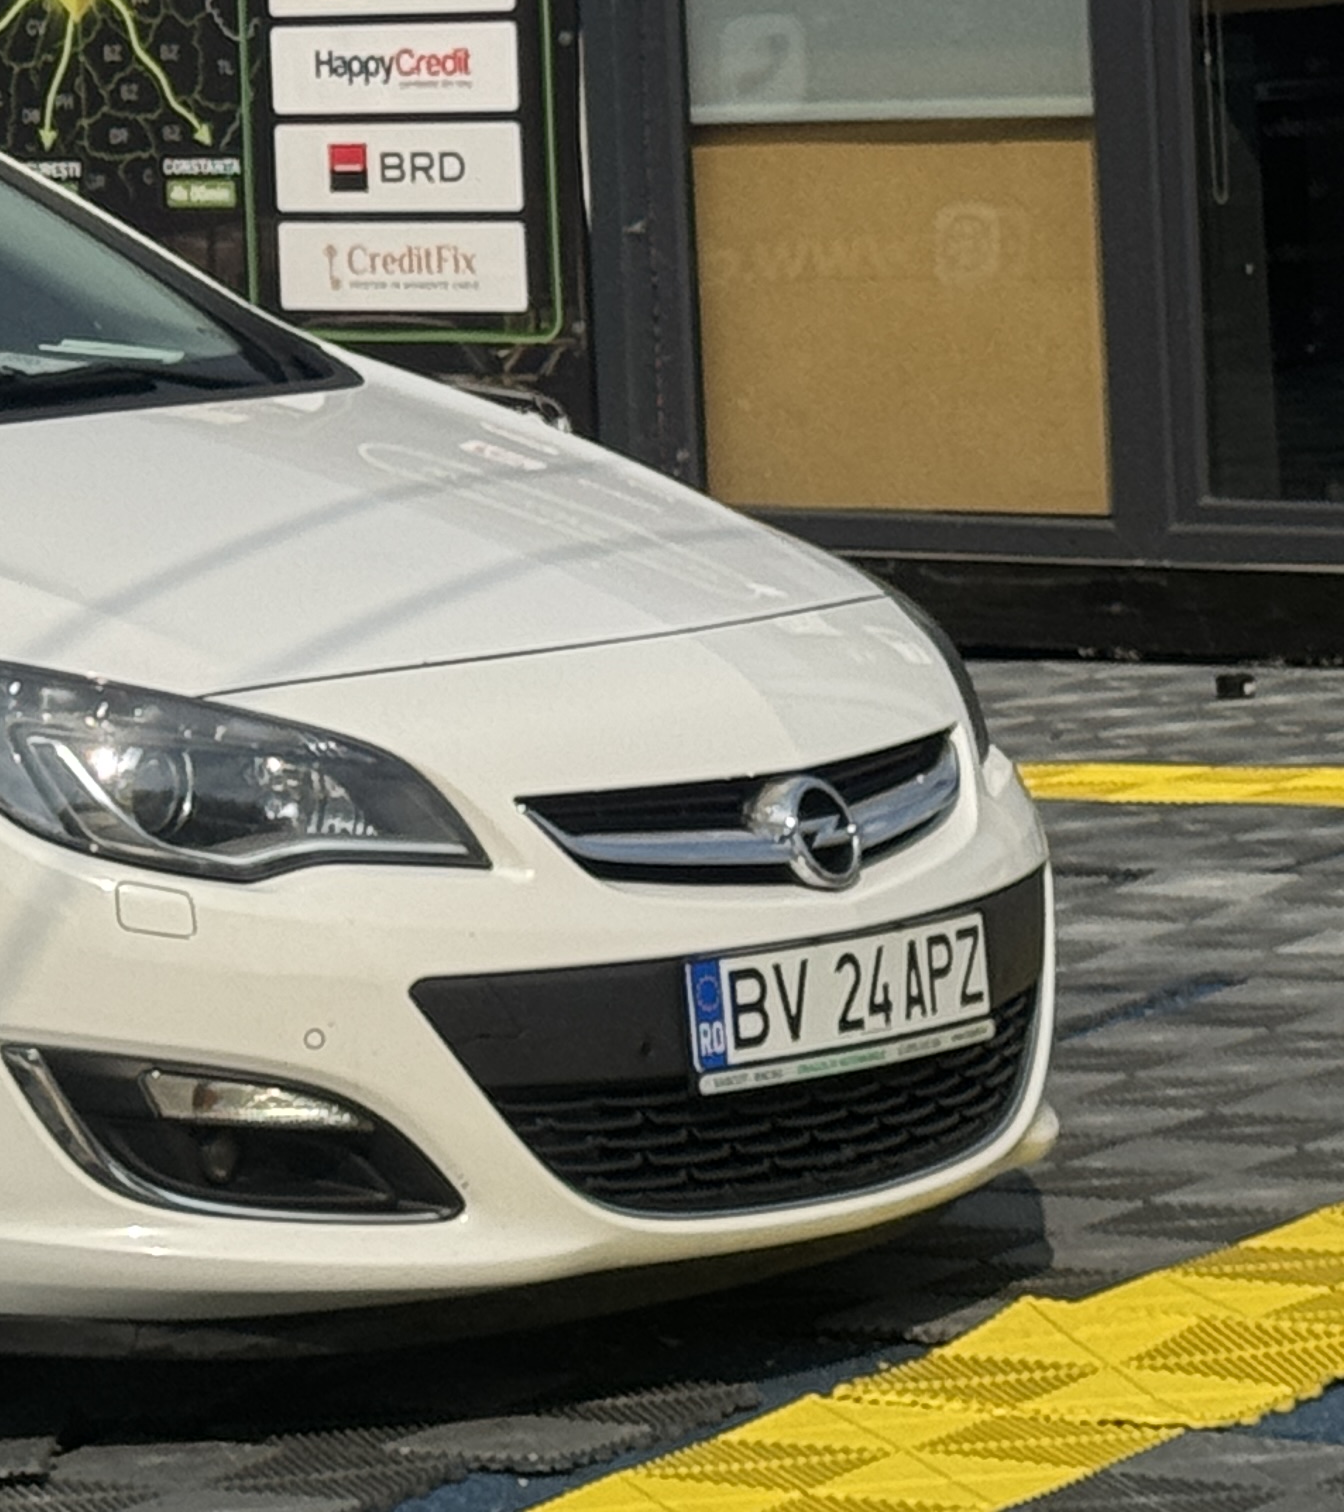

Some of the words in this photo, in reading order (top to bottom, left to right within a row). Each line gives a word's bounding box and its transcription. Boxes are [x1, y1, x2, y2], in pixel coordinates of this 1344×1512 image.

[314, 47, 471, 86] HappyCredit
[379, 151, 466, 184] BRD
[346, 243, 477, 276] CreditFix
[728, 957, 809, 1051] BV
[834, 944, 893, 1035] 24
[905, 924, 985, 1021] APZ
[698, 1020, 725, 1058] RO
